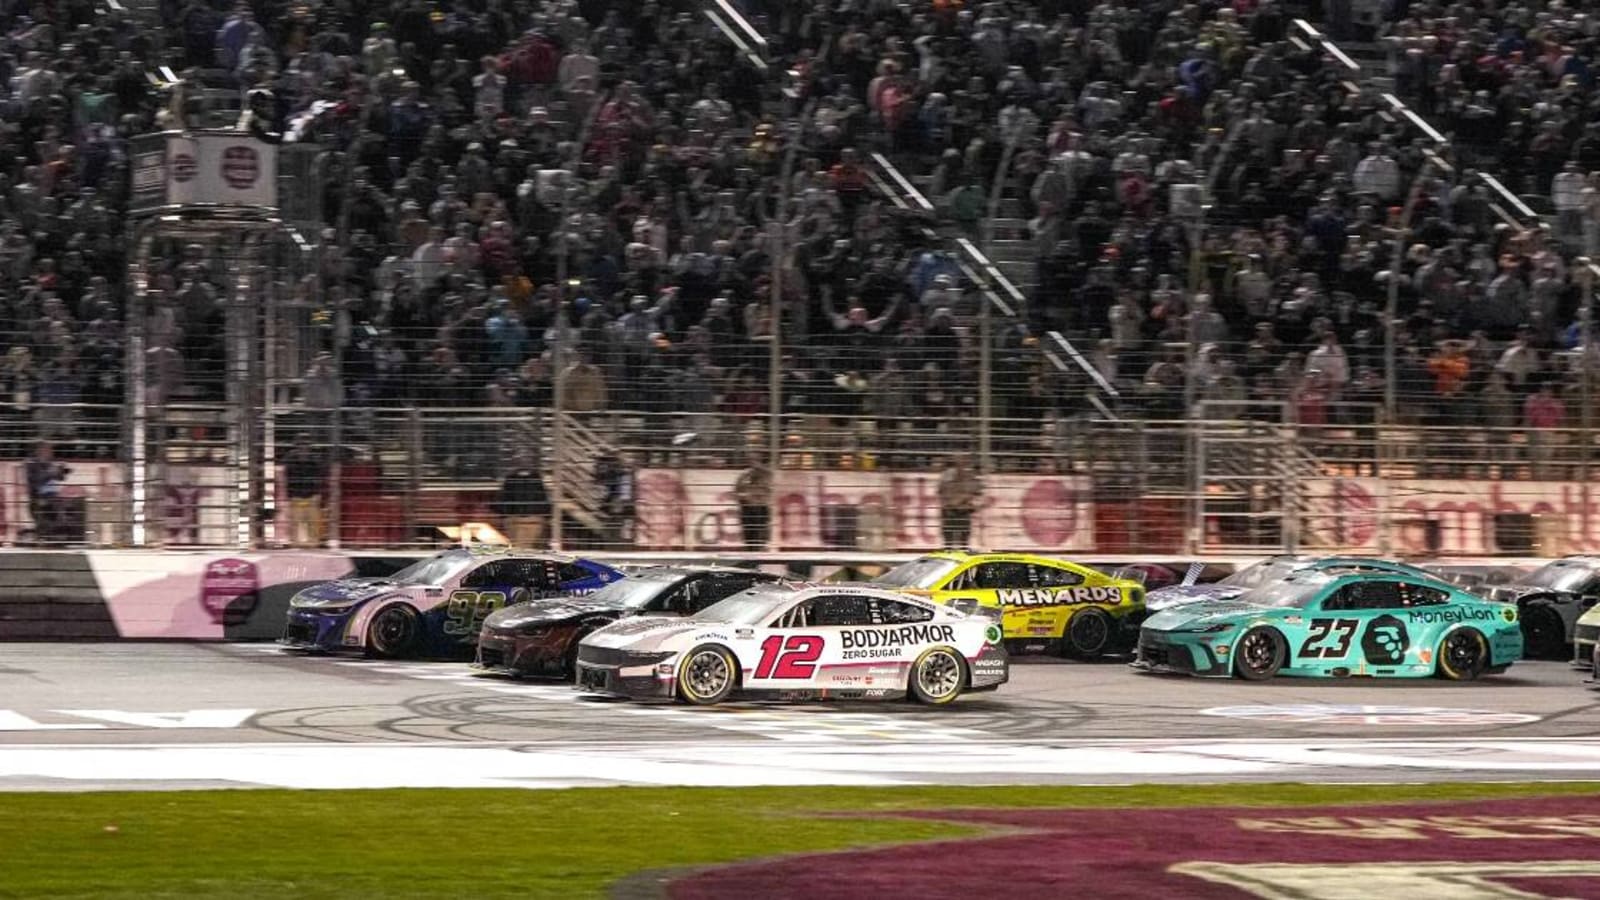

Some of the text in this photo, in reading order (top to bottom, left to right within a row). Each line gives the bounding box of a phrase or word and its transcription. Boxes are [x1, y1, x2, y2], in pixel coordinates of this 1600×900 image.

[996, 587, 1122, 606] MENARDS
[1408, 607, 1495, 623] MoneyLion
[840, 624, 956, 649] BODYARMOR
[1297, 618, 1360, 658] 23
[752, 635, 825, 679] 12
[842, 648, 902, 660] ZERO SUGAR
